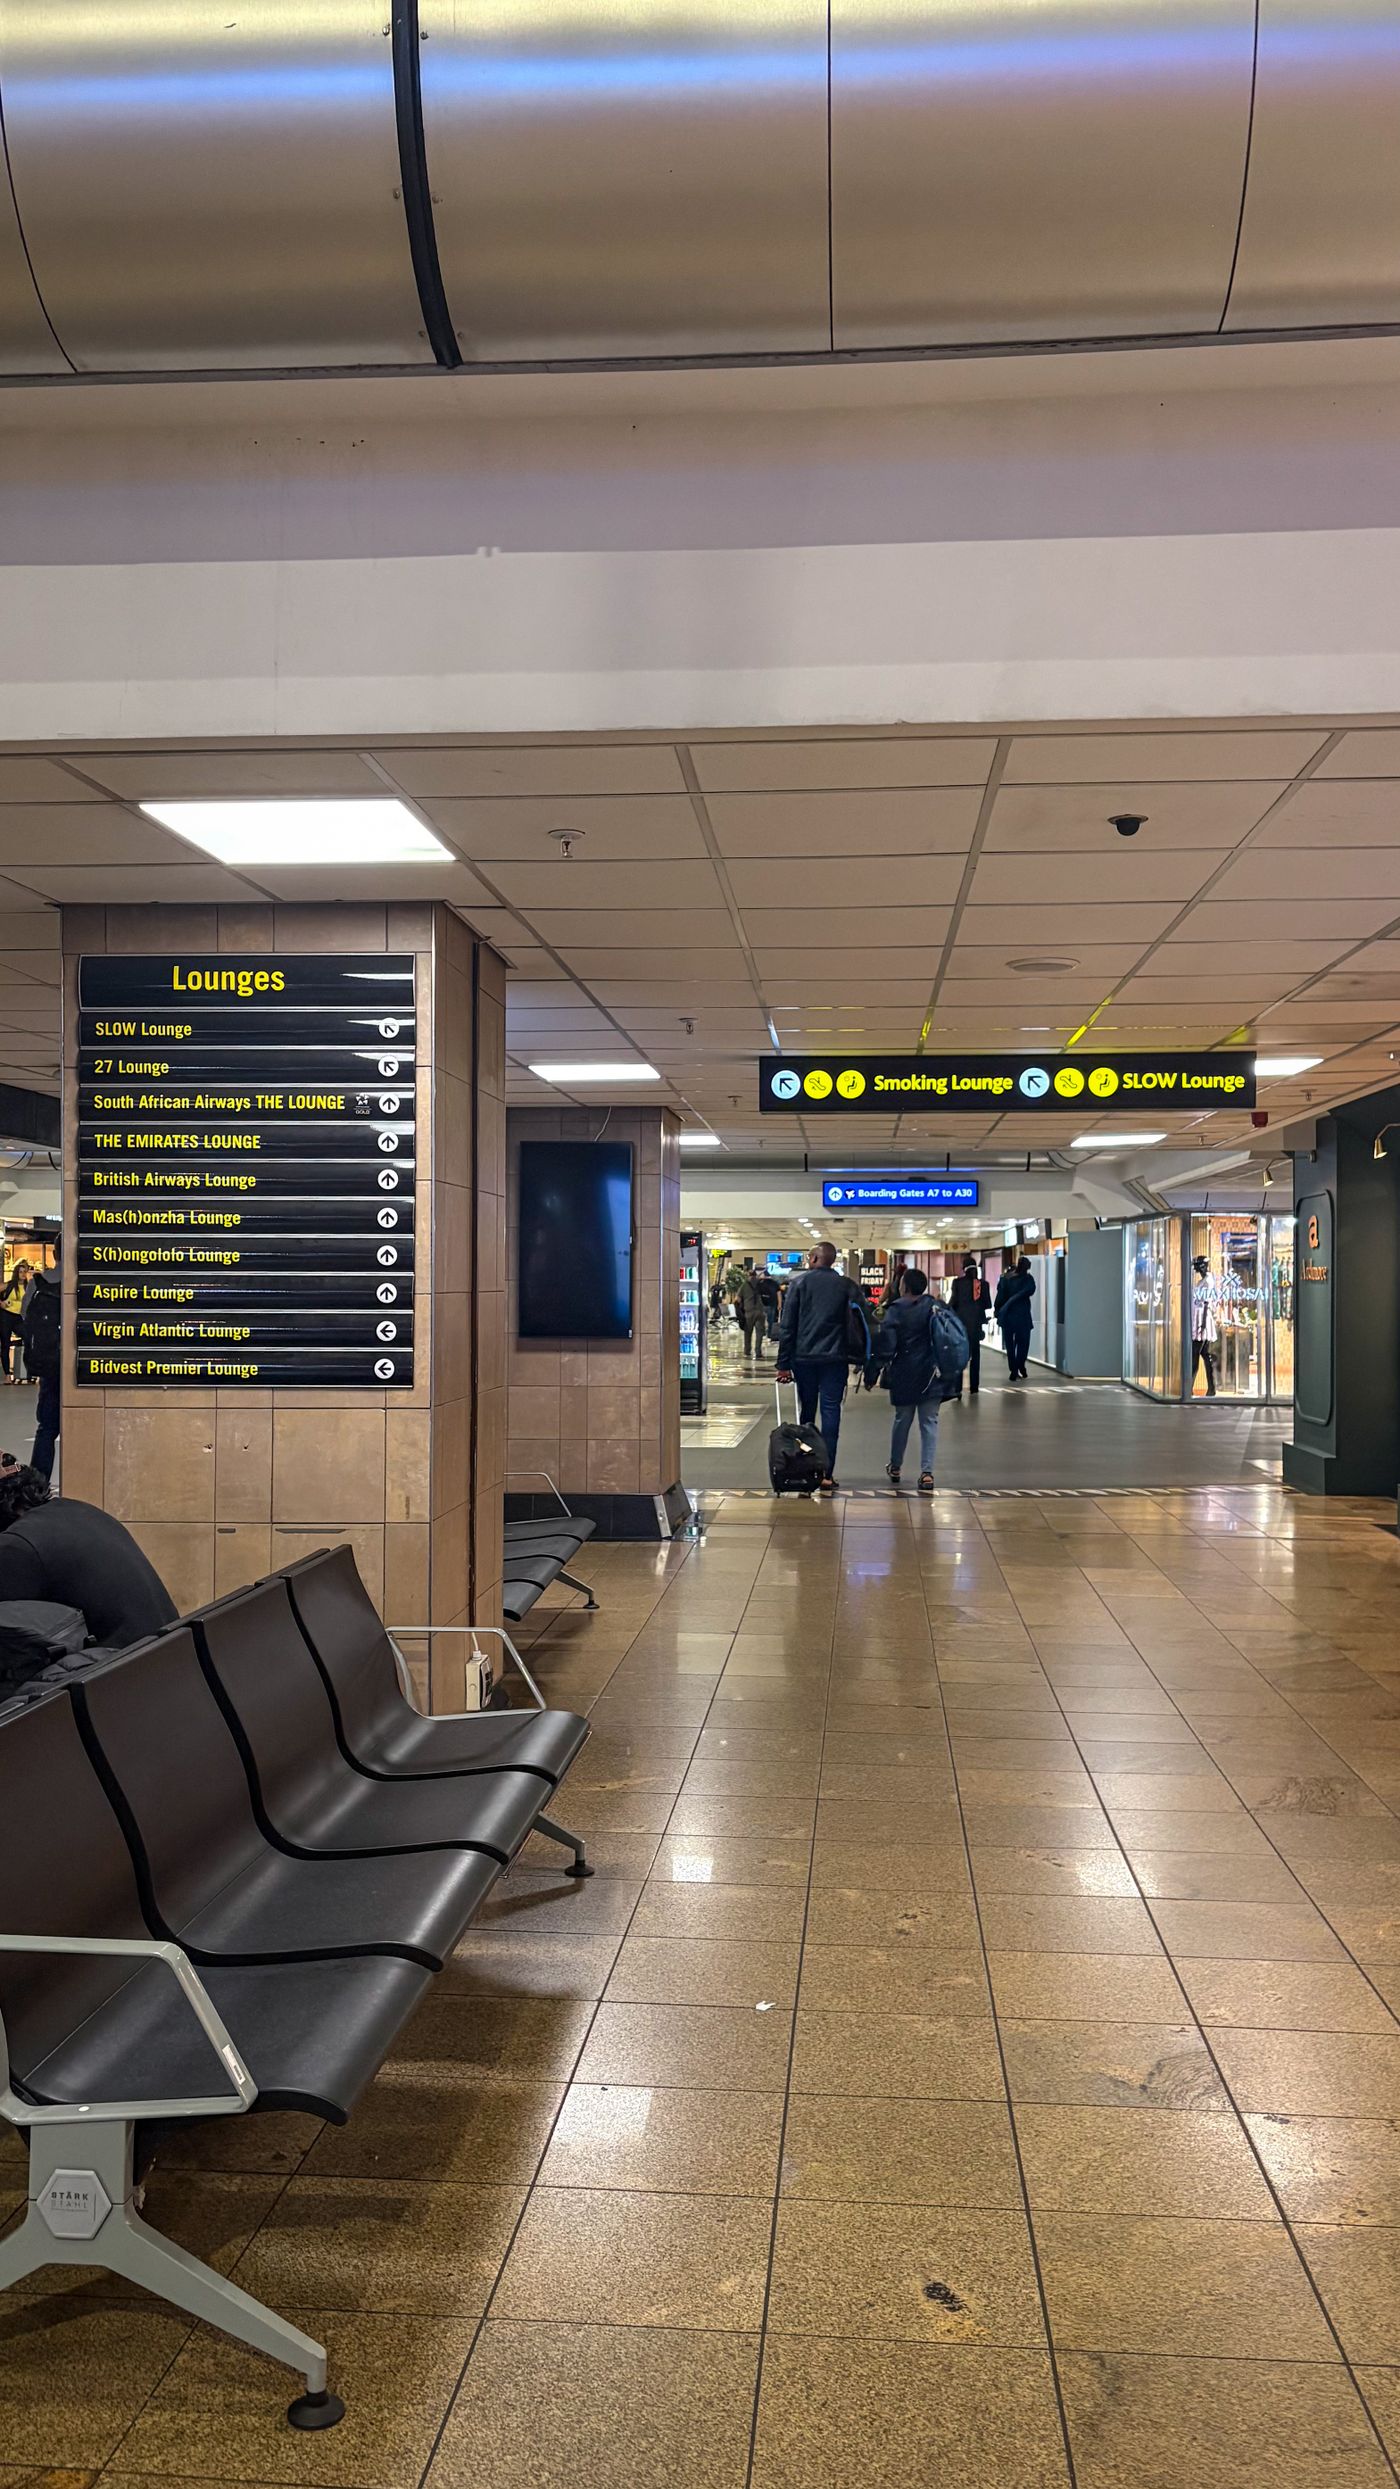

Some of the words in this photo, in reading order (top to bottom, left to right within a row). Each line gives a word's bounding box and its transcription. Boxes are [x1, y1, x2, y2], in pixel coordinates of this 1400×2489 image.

[172, 965, 286, 997] Lounges
[95, 1022, 137, 1037] SLOW
[141, 1022, 192, 1040] Lounge
[94, 1059, 113, 1074] 27
[118, 1059, 169, 1077] Lounge
[873, 1073, 949, 1095] Smoking
[951, 1073, 1014, 1095] Lounge
[1122, 1071, 1179, 1090] SLOW
[1181, 1071, 1246, 1094] Lounge
[93, 1094, 134, 1109] South
[138, 1094, 190, 1110] African
[193, 1094, 251, 1113] Airways
[255, 1094, 284, 1110] THE
[288, 1094, 345, 1111] LOUNGE
[94, 1133, 123, 1149] THE
[126, 1133, 199, 1149] EMIRATES
[203, 1133, 261, 1150] LOUNGE
[93, 1171, 140, 1188] British
[144, 1171, 201, 1191] Airways
[204, 1172, 257, 1191] Lounge
[858, 1188, 898, 1200] Boarding
[899, 1188, 925, 1198] Gates
[927, 1188, 940, 1198] A7
[942, 1189, 953, 1198] to
[954, 1188, 973, 1198] A30
[93, 1208, 185, 1227] Mas(h)onzha
[189, 1209, 242, 1228] Lounge
[93, 1246, 185, 1266] S(h)ongololo
[188, 1246, 241, 1266] Lounge
[860, 1267, 884, 1276] BLACK
[860, 1277, 884, 1286] FRIDAY
[93, 1283, 138, 1302] Aspire
[142, 1284, 194, 1303] Lounge
[92, 1321, 135, 1340] Virgin
[139, 1321, 195, 1338] Atlantic
[199, 1323, 251, 1341] Lounge
[90, 1359, 143, 1376] Bidvest
[146, 1359, 202, 1376] Premier
[207, 1360, 259, 1379] Lounge
